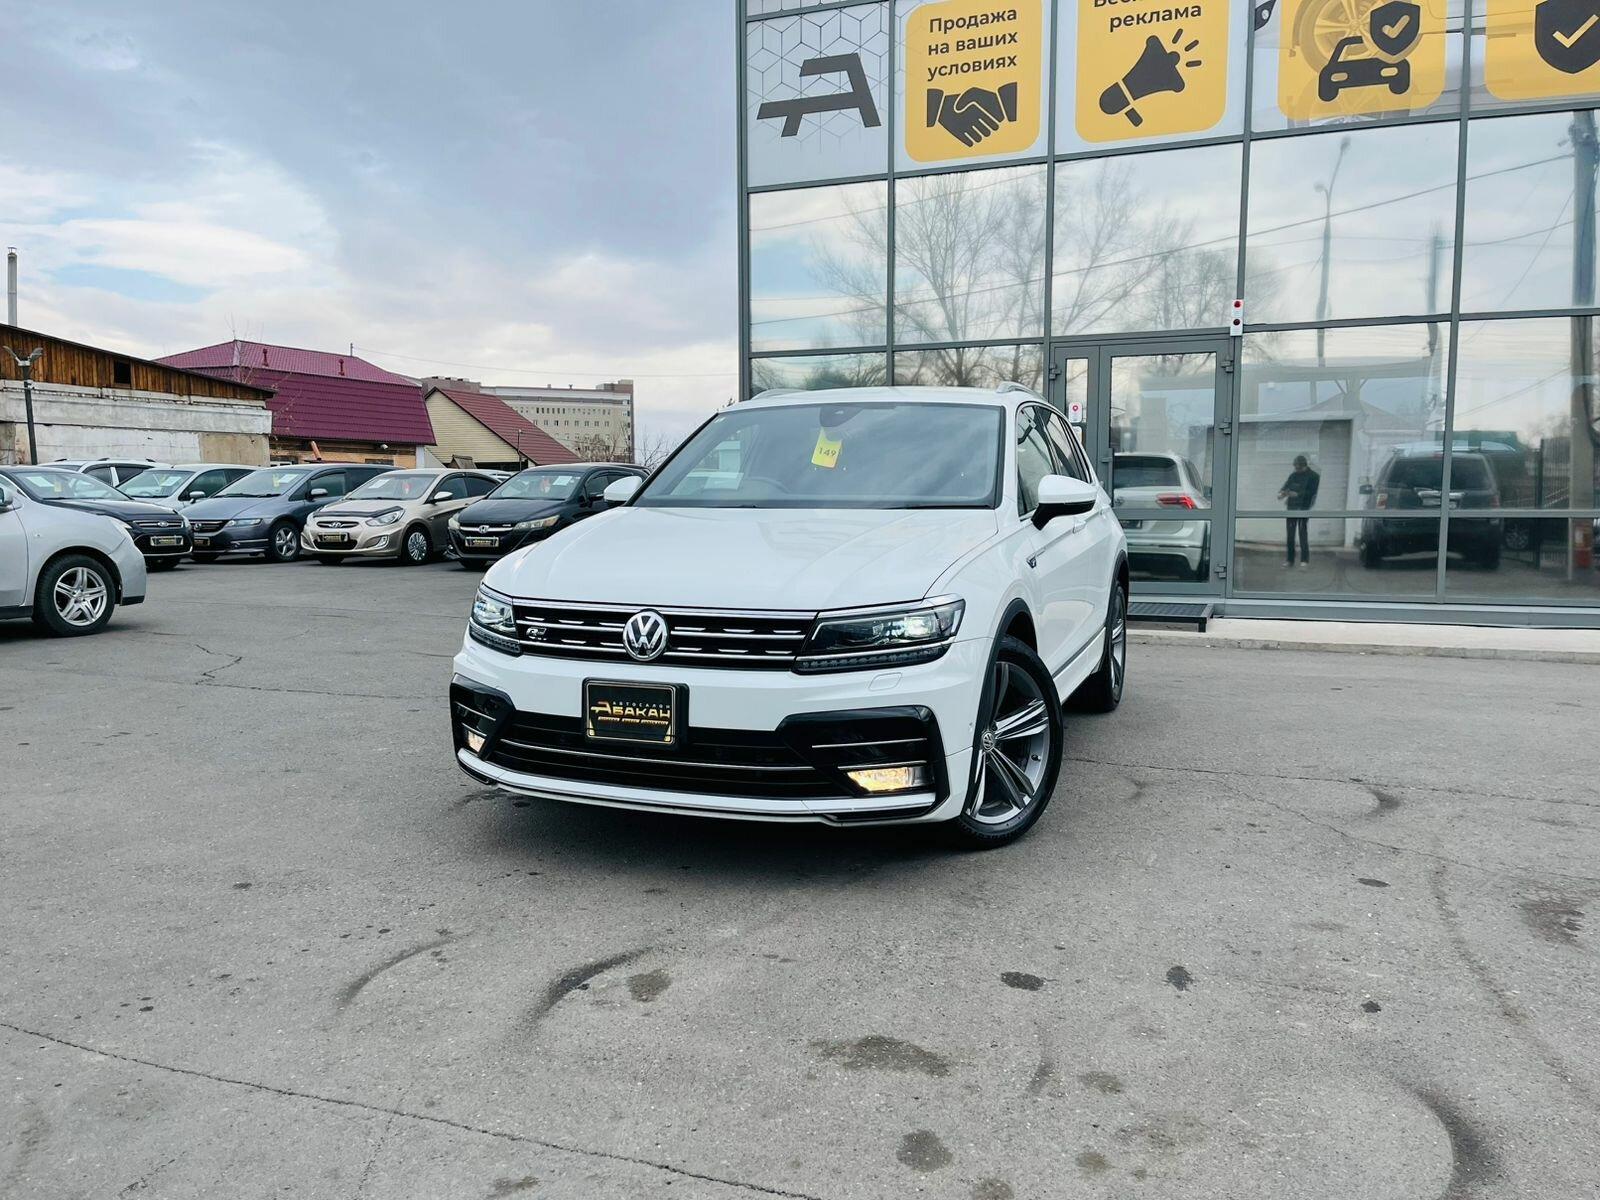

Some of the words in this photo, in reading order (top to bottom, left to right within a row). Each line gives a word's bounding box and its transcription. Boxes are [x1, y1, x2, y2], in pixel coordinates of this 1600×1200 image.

[929, 9, 1017, 34] Продажа
[1110, 5, 1202, 32] реклама
[928, 42, 949, 55] на
[956, 31, 1018, 52] ваших
[927, 55, 1017, 82] условиях
[819, 447, 837, 457] 149
